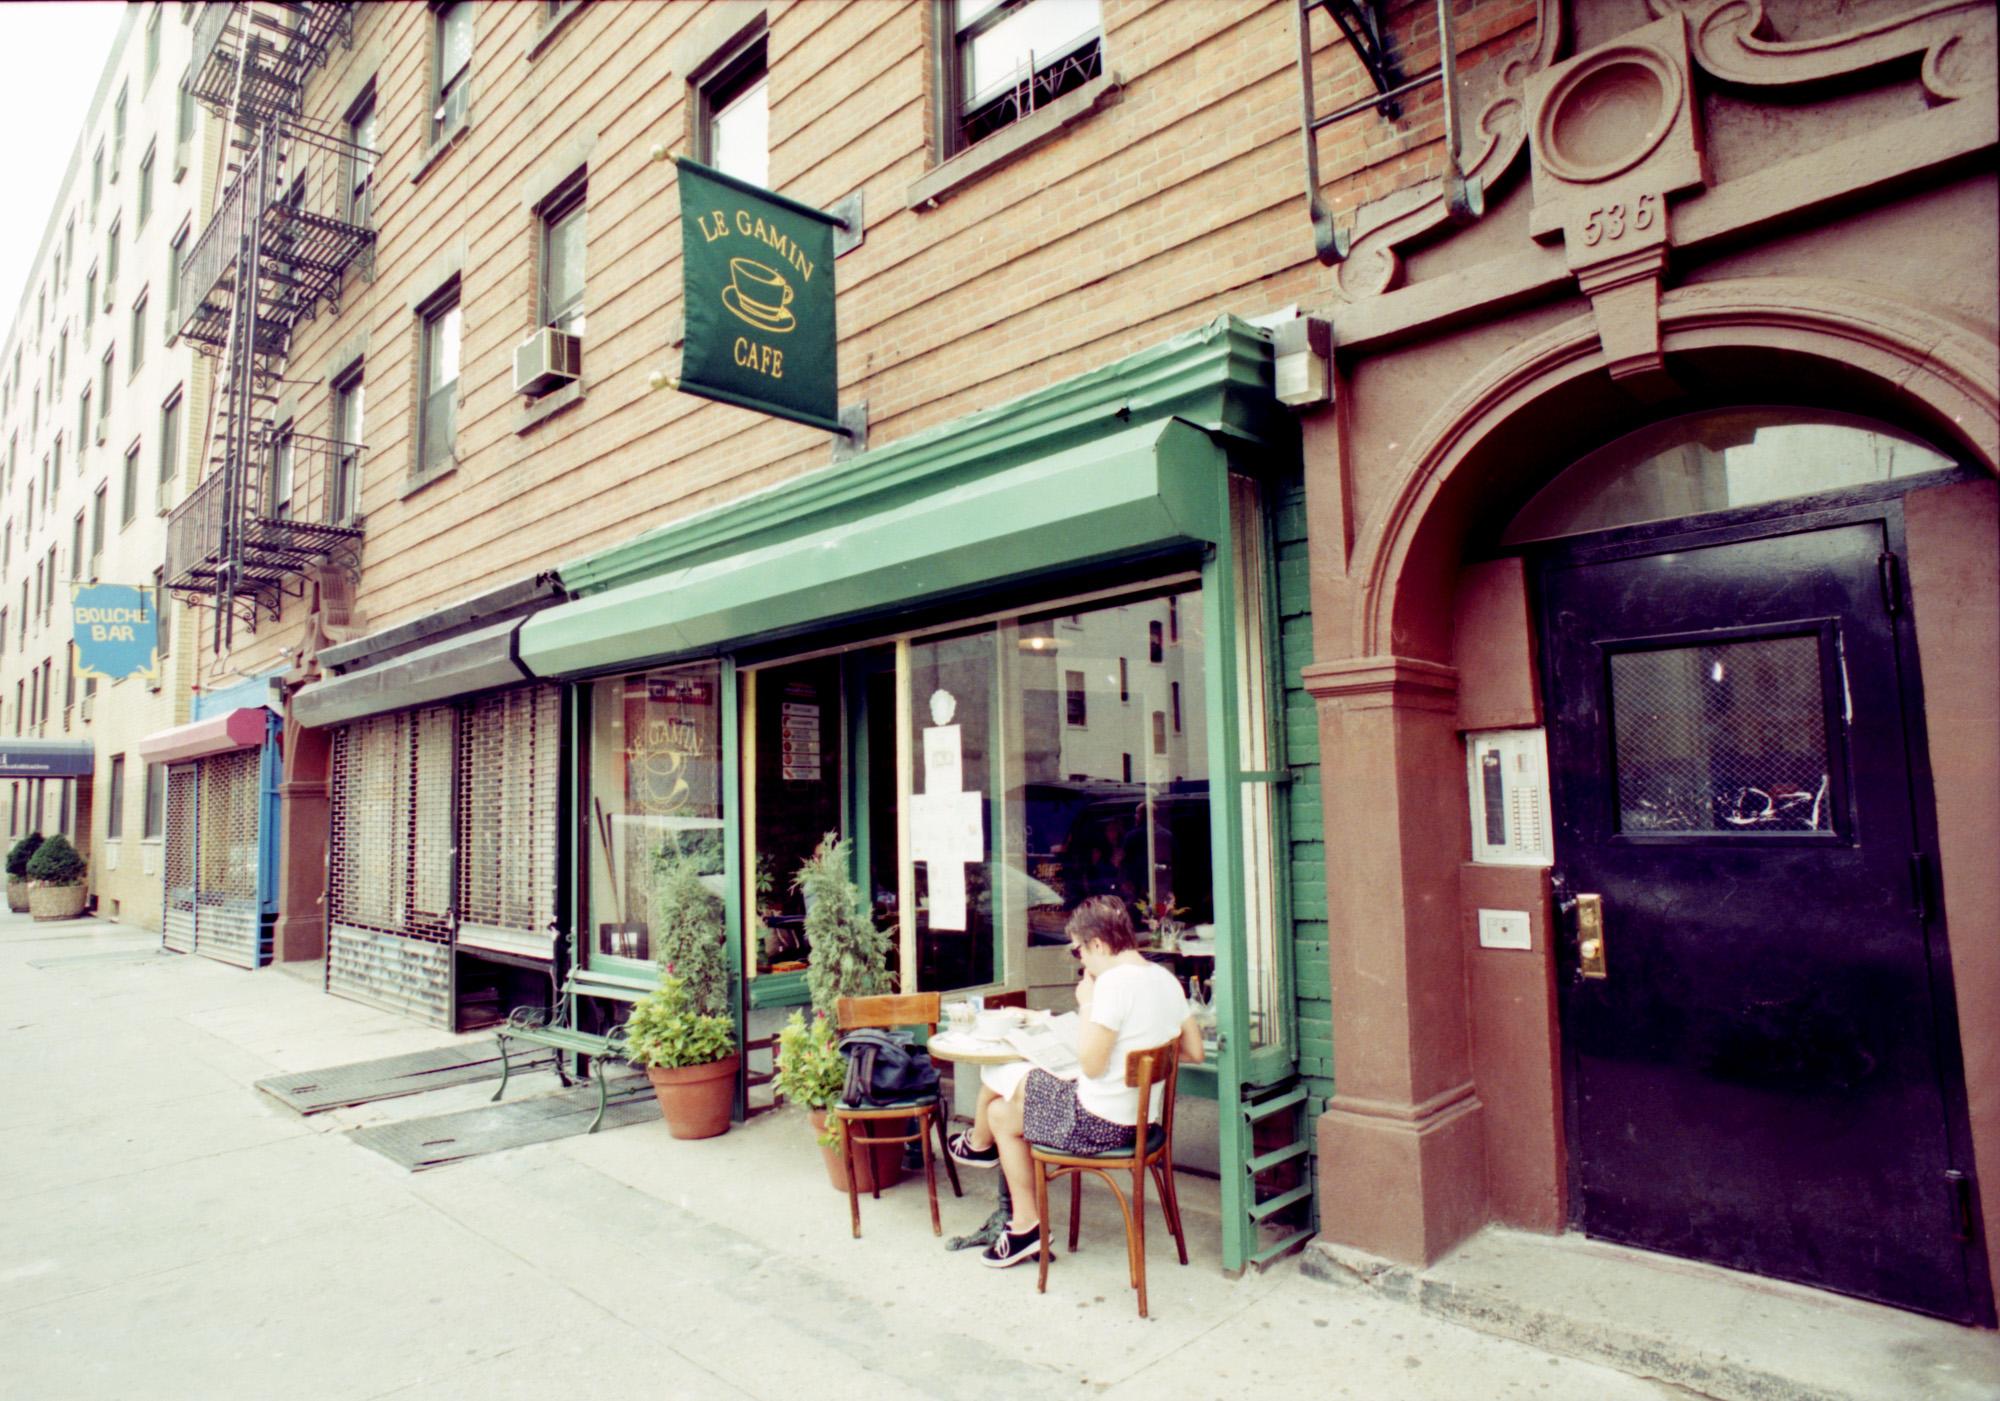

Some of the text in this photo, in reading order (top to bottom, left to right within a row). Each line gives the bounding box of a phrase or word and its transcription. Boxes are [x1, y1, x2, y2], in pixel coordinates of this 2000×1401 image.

[1585, 194, 1655, 246] 536
[698, 210, 814, 282] LE GAMIN
[734, 337, 783, 378] CAFE
[76, 608, 150, 623] BOUCHE
[92, 624, 135, 641] BAR
